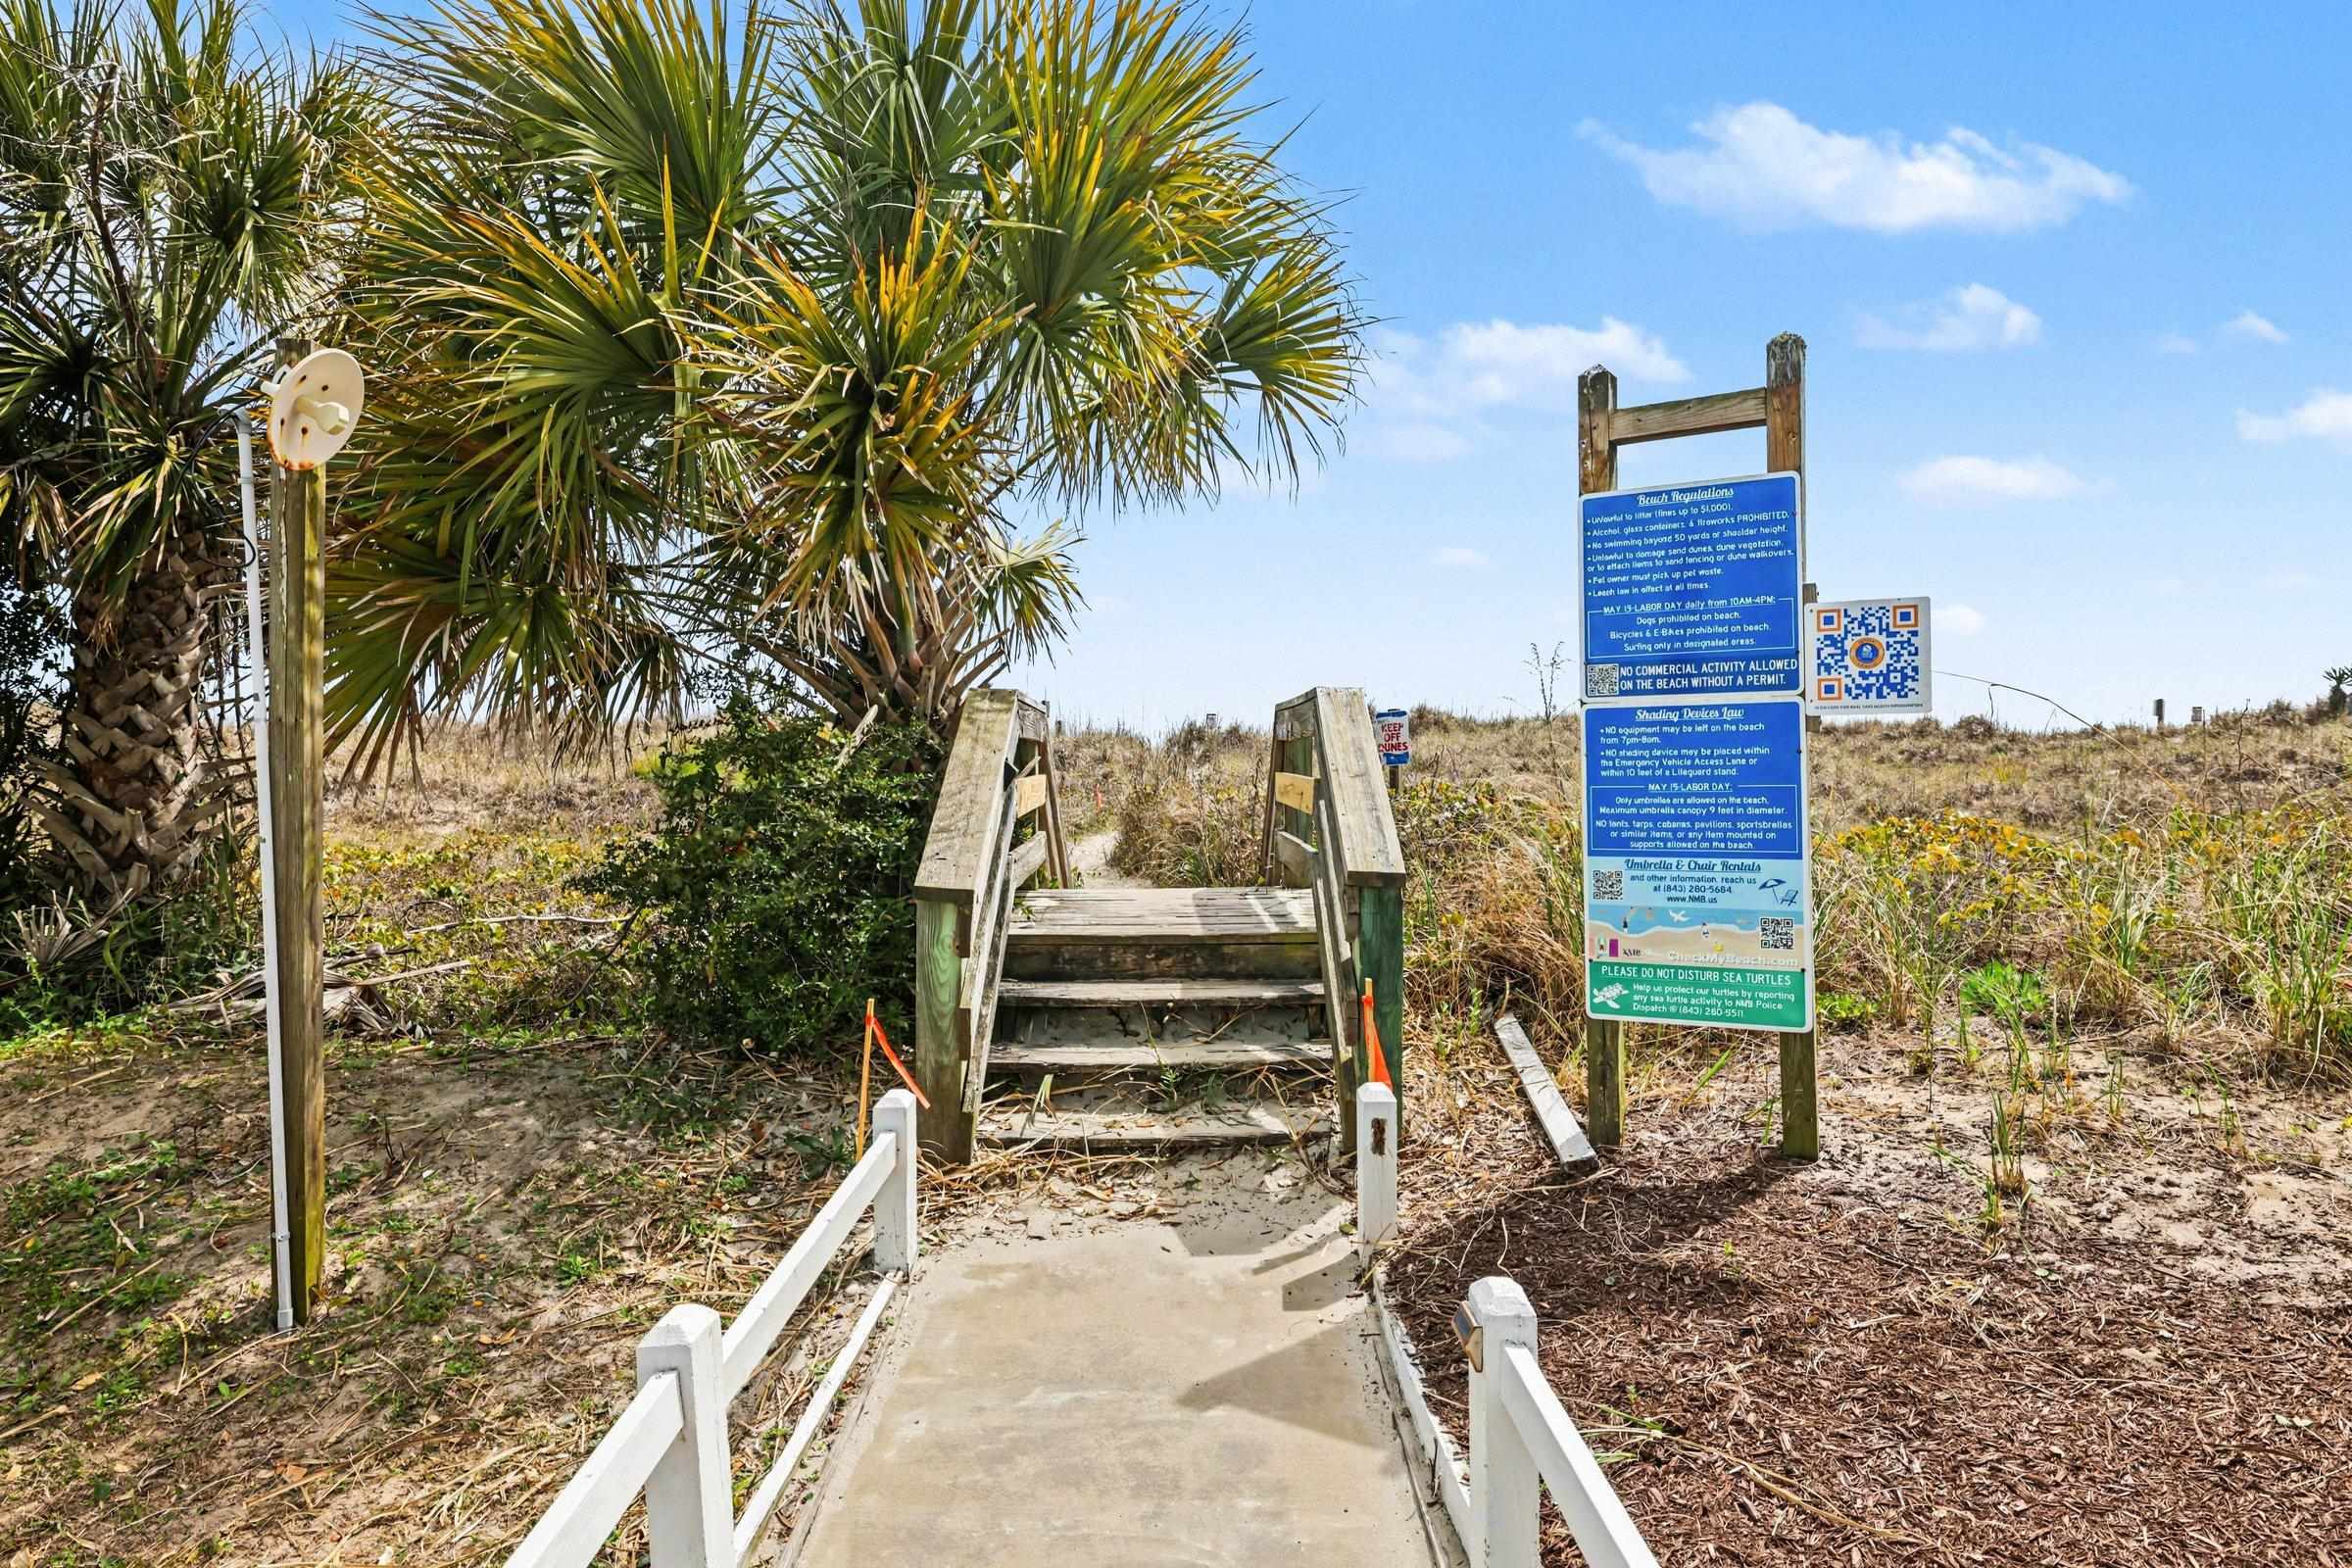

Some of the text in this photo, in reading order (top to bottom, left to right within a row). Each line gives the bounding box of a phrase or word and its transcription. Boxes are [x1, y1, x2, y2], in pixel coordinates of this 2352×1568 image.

[1637, 487, 1734, 505] Beach Regulations
[1592, 514, 1623, 524] Unlawful
[1624, 512, 1788, 534] glass fireworks PROHIBITED.
[1604, 538, 1642, 548] swimming
[1643, 535, 1672, 546] beyond
[1688, 532, 1710, 541] yards
[1723, 528, 1757, 537] shoulder
[1760, 524, 1788, 533] height.
[1592, 553, 1623, 562] Unlawful
[1636, 548, 1665, 558] damage
[1686, 554, 1714, 564] fencing
[1653, 572, 1669, 582] pick
[1684, 569, 1695, 578] pet
[1642, 584, 1662, 593] effect
[1686, 600, 1704, 609] daily
[1637, 616, 1656, 625] Dogs
[1658, 614, 1699, 625] prohibited
[1610, 630, 1642, 640] Bicycles
[1687, 624, 1729, 636] prohibited
[1744, 622, 1771, 631] beach.
[1624, 643, 1651, 652] Surfing
[1654, 642, 1671, 651] only
[1684, 638, 1729, 650] designated
[1620, 659, 1797, 676] NO COMMERCIAL ACTIVITY ALLOWED
[1621, 673, 1786, 690] ON THE BEACH WITHOUT A PERMIT.
[1636, 707, 1744, 722] Shading Devices Law
[1381, 722, 1403, 732] KEEP
[1619, 725, 1659, 735] equipment
[1384, 733, 1400, 742] OFF
[1379, 742, 1408, 753] DUNES
[1619, 749, 1649, 758] shading
[1714, 747, 1741, 756] placed
[1743, 746, 1770, 755] within
[1615, 759, 1659, 768] Emergency
[1672, 767, 1711, 777] Lifeguard
[1616, 797, 1632, 806] Only
[1678, 807, 1706, 815] canopy
[1631, 841, 1663, 851] supports
[1625, 858, 1761, 871] Umbrella & Chair Rentals
[1721, 875, 1743, 884] reach
[1663, 884, 1685, 893] (843)
[1689, 885, 1732, 894] 280-5684
[1601, 965, 1790, 986] PLEASE DO NOT DISTURB SEA TURTLES
[1633, 984, 1650, 993] Help
[1665, 986, 1693, 996] protect
[1713, 988, 1739, 997] turtles
[1741, 990, 1751, 999] by
[1755, 991, 1794, 1002] reporting
[1690, 997, 1722, 1007] activity
[1756, 1001, 1783, 1009] Police
[1633, 1004, 1667, 1012] Dispatch
[1679, 1006, 1702, 1015] (843)
